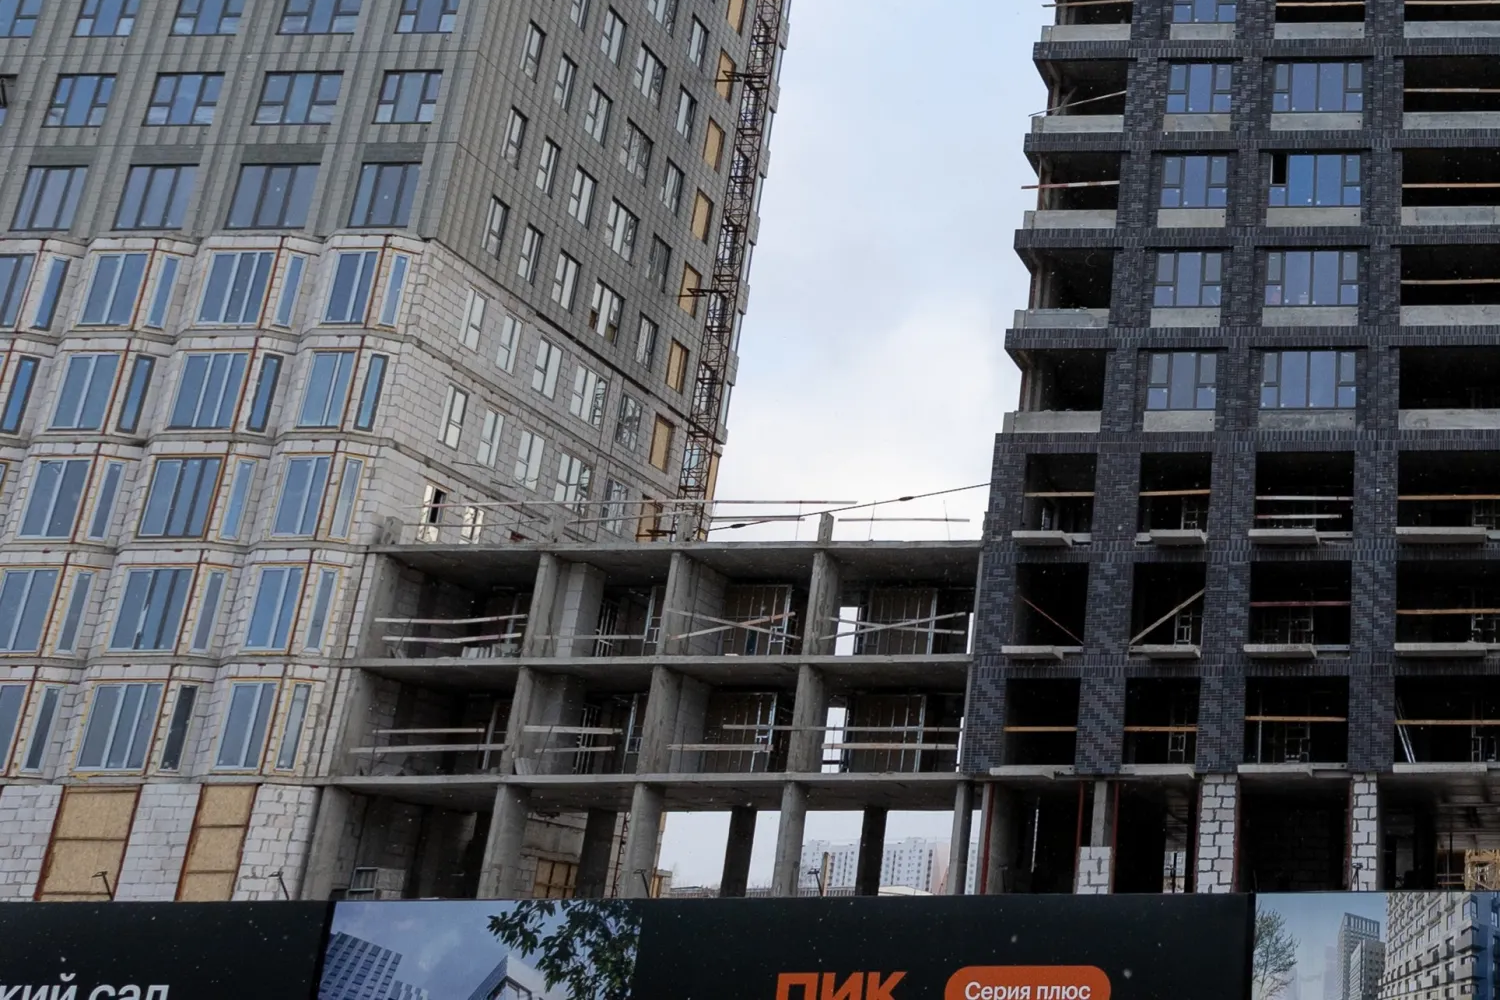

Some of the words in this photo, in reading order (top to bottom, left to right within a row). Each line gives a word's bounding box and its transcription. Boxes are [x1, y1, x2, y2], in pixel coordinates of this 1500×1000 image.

[776, 971, 907, 1000] ПИК
[964, 981, 1030, 1000] Серия
[1036, 983, 1091, 1000] плюс
